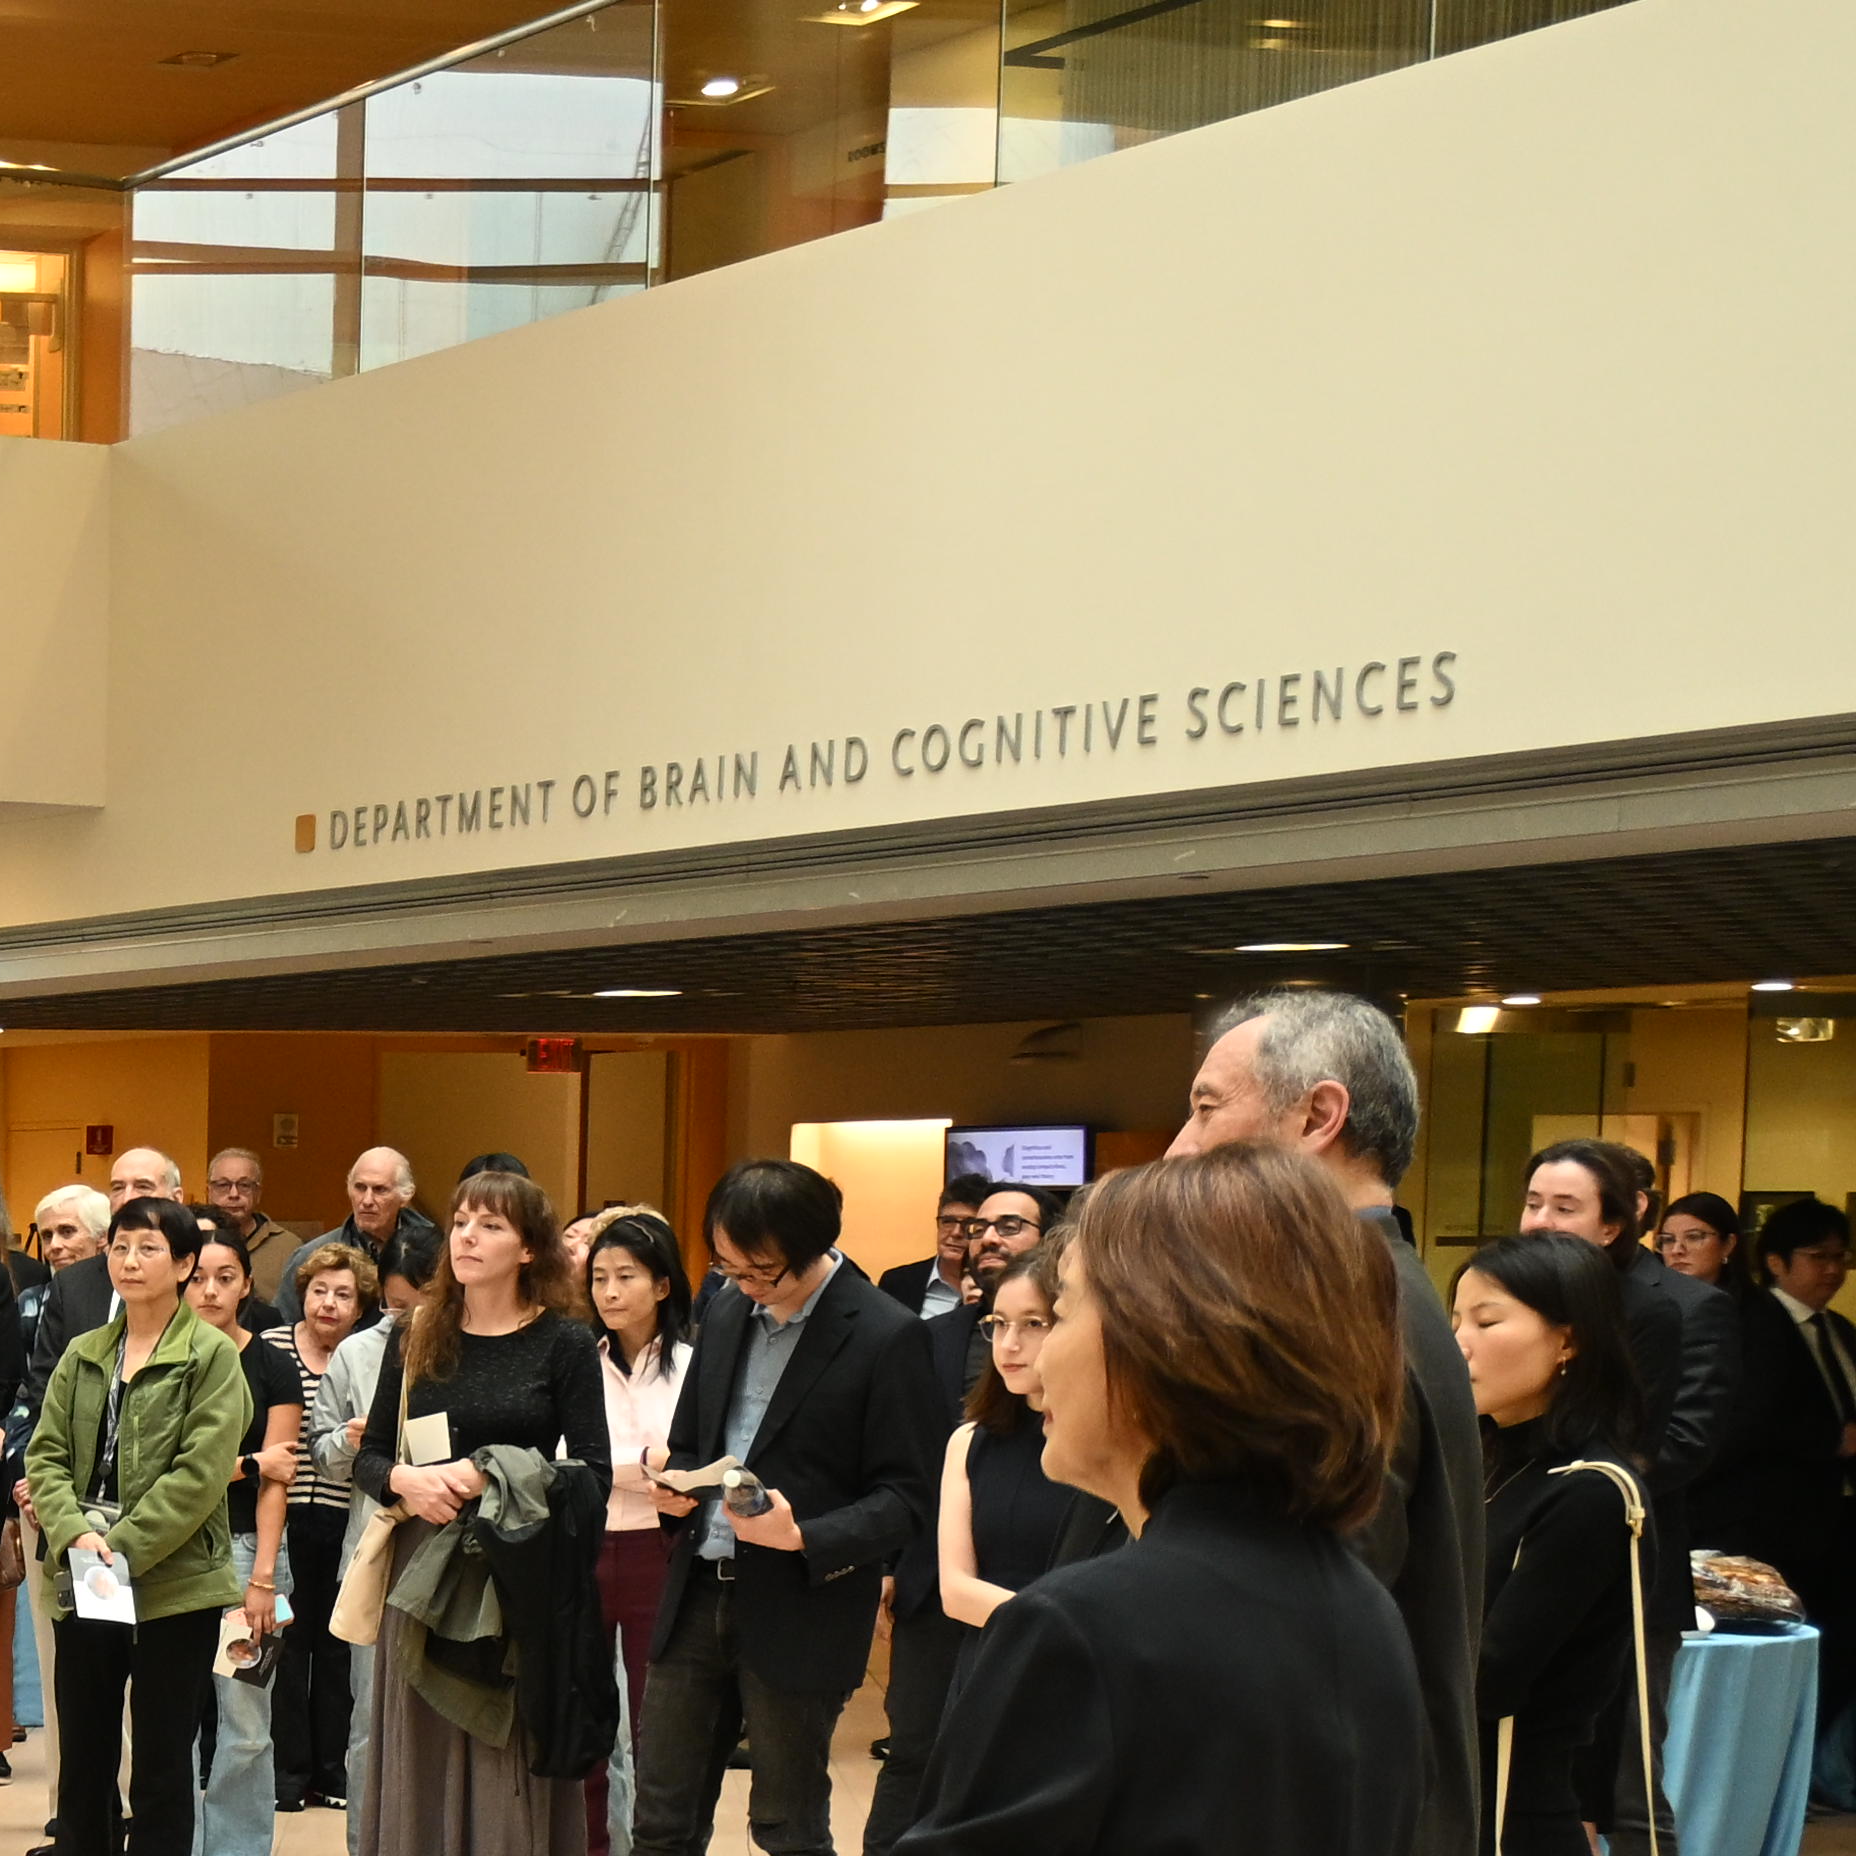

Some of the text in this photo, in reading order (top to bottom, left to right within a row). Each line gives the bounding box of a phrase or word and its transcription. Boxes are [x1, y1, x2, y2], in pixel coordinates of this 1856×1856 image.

[329, 651, 1457, 850] DEPARTMENT OF BRAIN AND COGNITIVE SCIENCES
